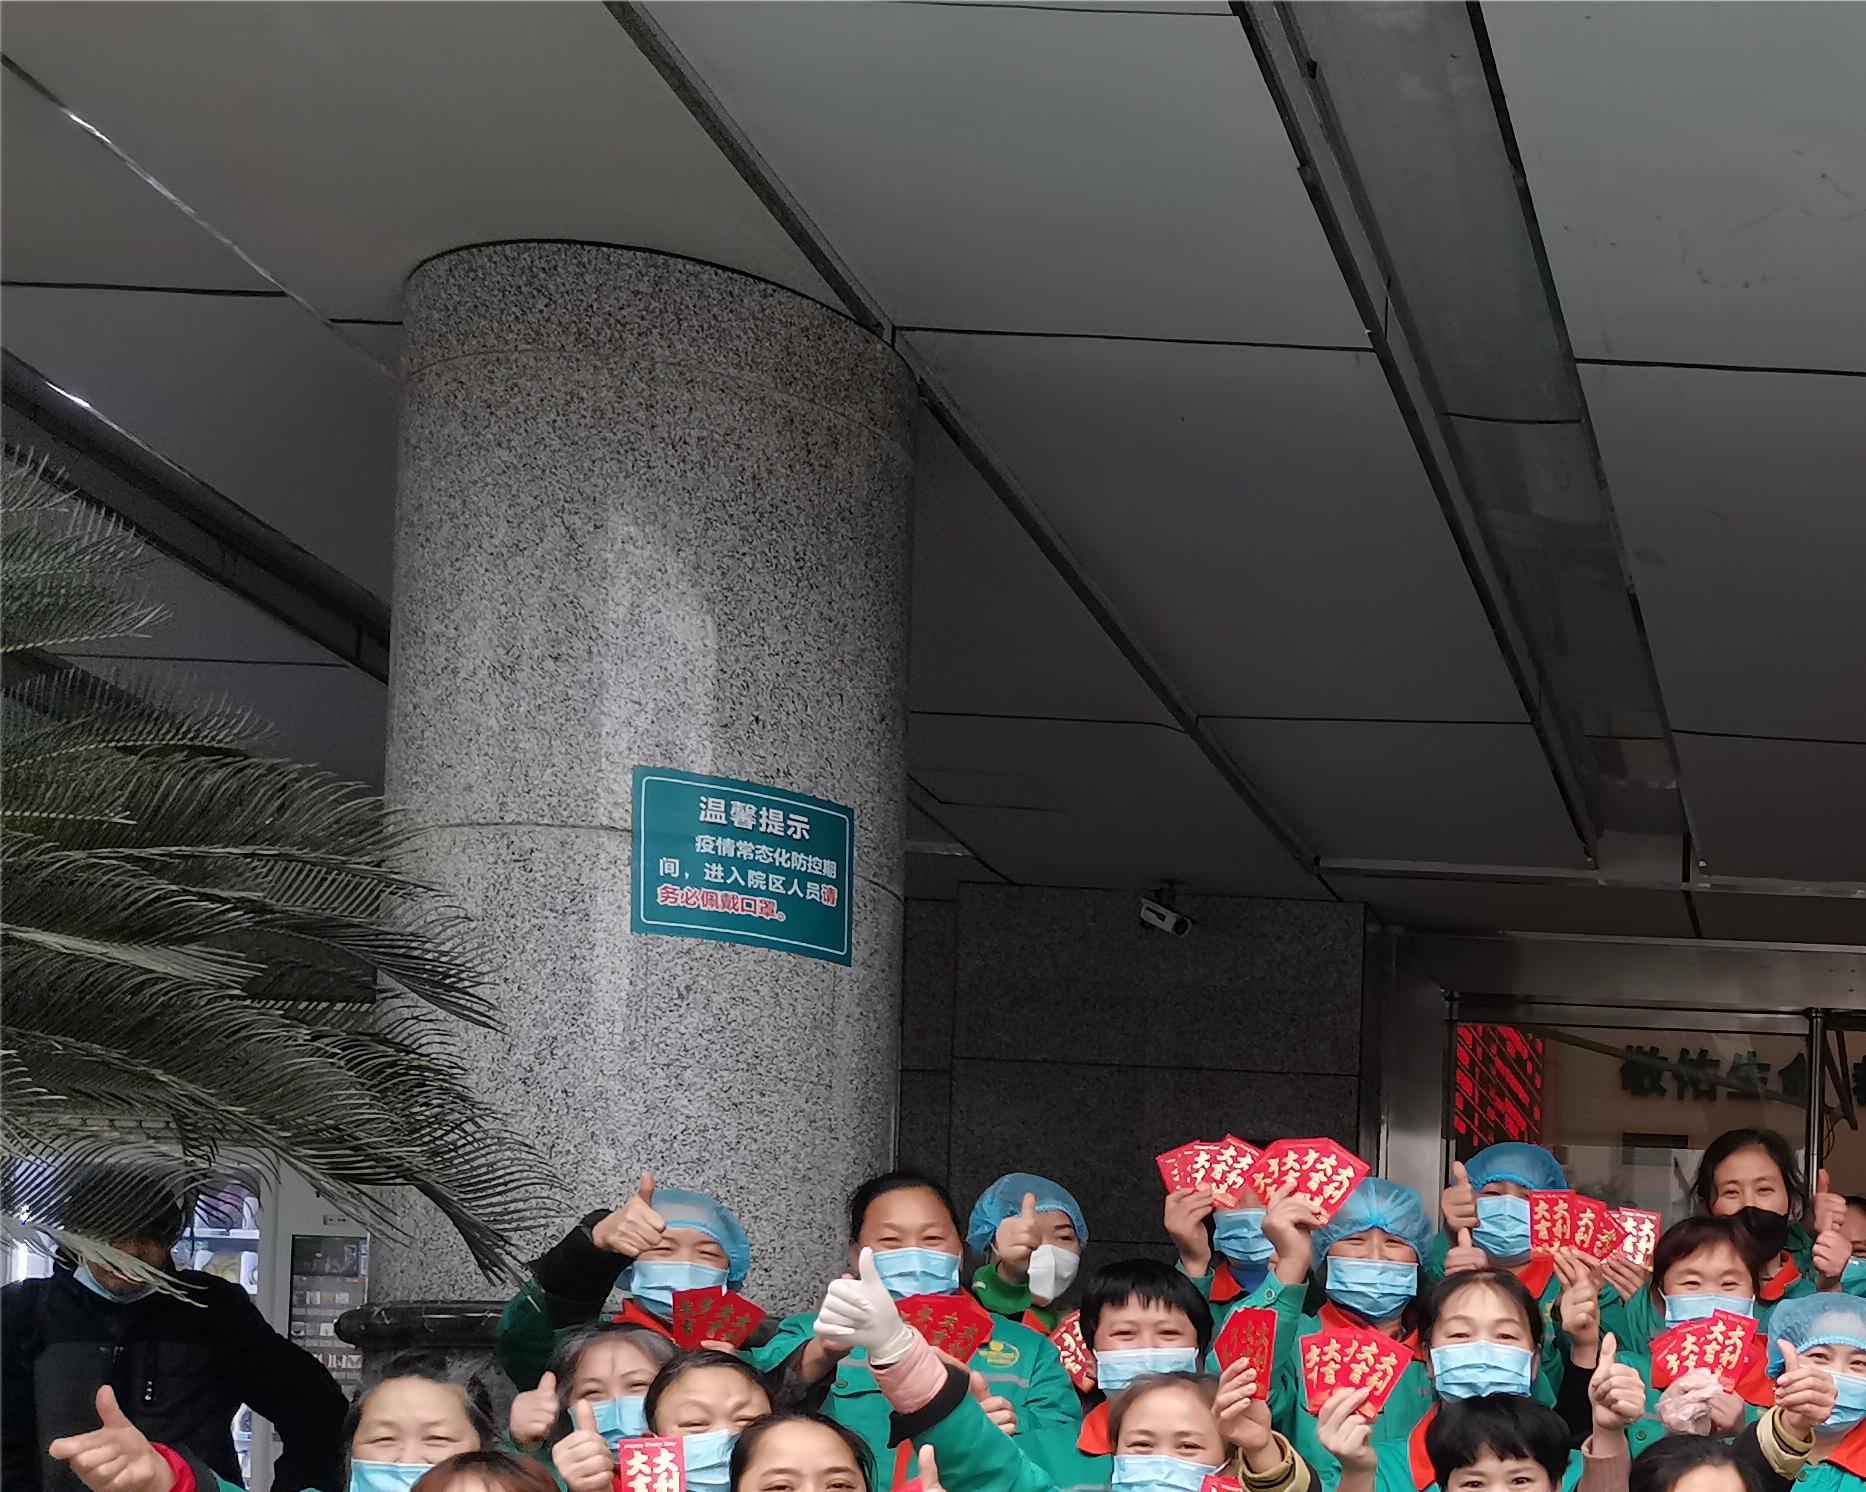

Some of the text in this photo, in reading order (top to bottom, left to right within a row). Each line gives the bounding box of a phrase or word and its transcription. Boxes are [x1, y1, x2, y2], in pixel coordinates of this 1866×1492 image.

[699, 796, 811, 841] 温馨提示
[695, 834, 837, 879] 疫情常态化防控期
[657, 883, 786, 922] 务必佩戴口罩。
